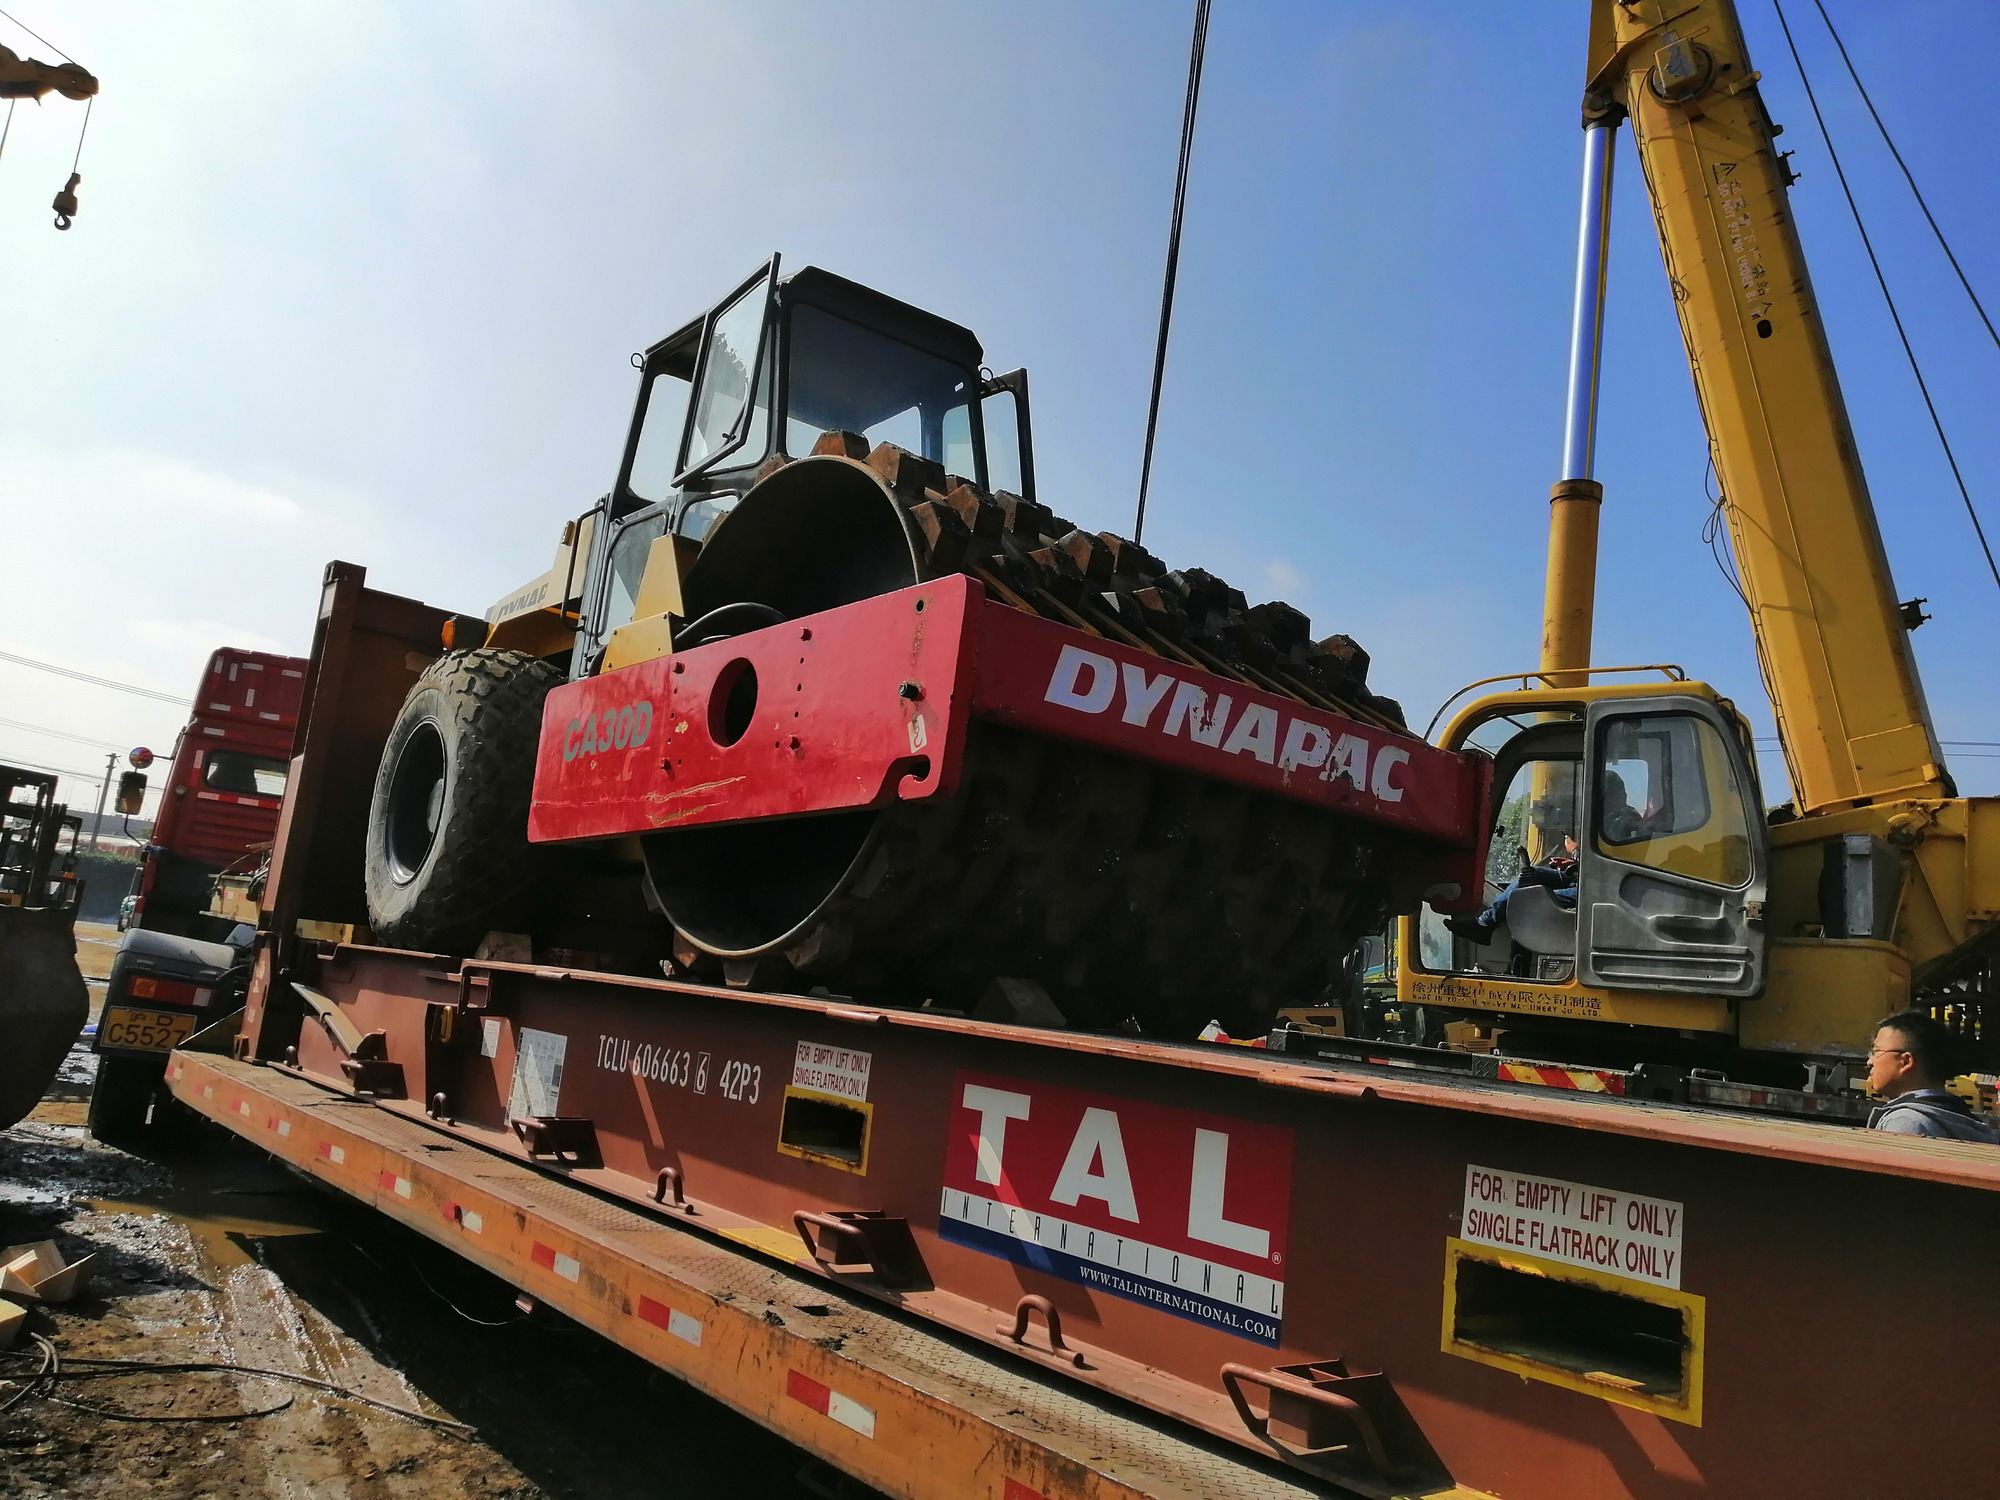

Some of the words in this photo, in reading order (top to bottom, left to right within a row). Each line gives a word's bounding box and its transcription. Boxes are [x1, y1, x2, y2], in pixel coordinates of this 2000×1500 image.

[1721, 198, 1736, 219] NOT
[1727, 219, 1745, 253] STAND
[1736, 254, 1754, 289] UNDER
[563, 701, 653, 763] CA30D
[1043, 643, 1411, 803] DYNAPAC
[108, 1023, 187, 1048] C5527
[797, 1044, 811, 1063] FOR
[813, 1048, 834, 1067] EMPTY
[835, 1052, 849, 1070] LIFT
[851, 1054, 870, 1074] ONLY
[597, 1035, 631, 1073] TCLU
[633, 1043, 691, 1088] 606663
[696, 1055, 708, 1091] 6
[720, 1060, 761, 1105] 42P3
[794, 1066, 816, 1086] SINGLE
[816, 1071, 848, 1095] FLATRACK
[848, 1078, 866, 1098] ONLY
[962, 1083, 1270, 1259] TAL
[1470, 1171, 1503, 1204] FOR
[1515, 1180, 1571, 1216] EMPTY
[1580, 1191, 1617, 1226] LIFT
[1626, 1200, 1677, 1238] ONLY
[942, 1189, 1278, 1315] INTERNATIONAL
[1467, 1208, 1526, 1246] SINGLE
[1530, 1221, 1620, 1268] FLATRACK
[1625, 1241, 1675, 1280] ONLY
[1080, 1265, 1277, 1341] WWW.TALINTERNATIONAL.COM
